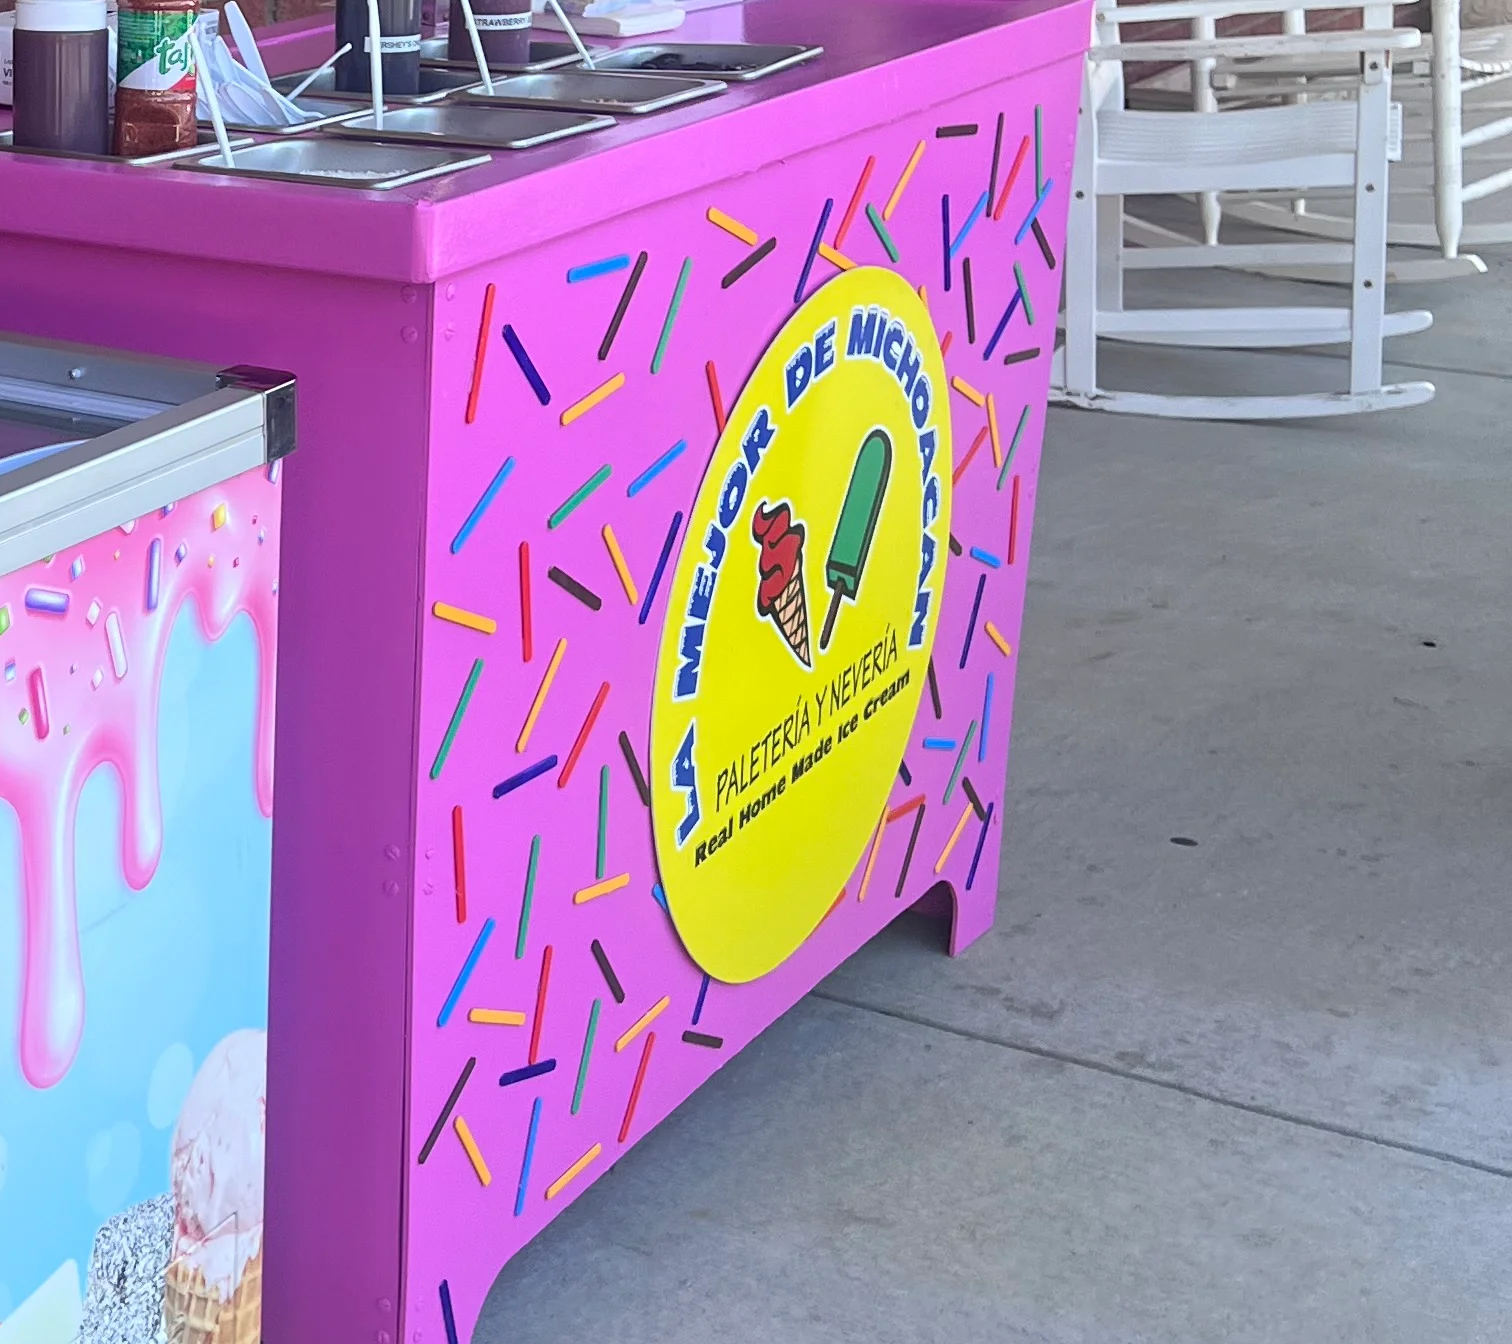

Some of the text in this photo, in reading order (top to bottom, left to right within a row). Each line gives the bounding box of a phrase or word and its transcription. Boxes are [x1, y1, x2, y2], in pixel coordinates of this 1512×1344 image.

[674, 307, 940, 845] LA MEJOR DE MICHOACAN
[694, 668, 910, 868] Real Home Made Ice Cream
[716, 622, 898, 812] PALETERÍA Y NEVERÍA
